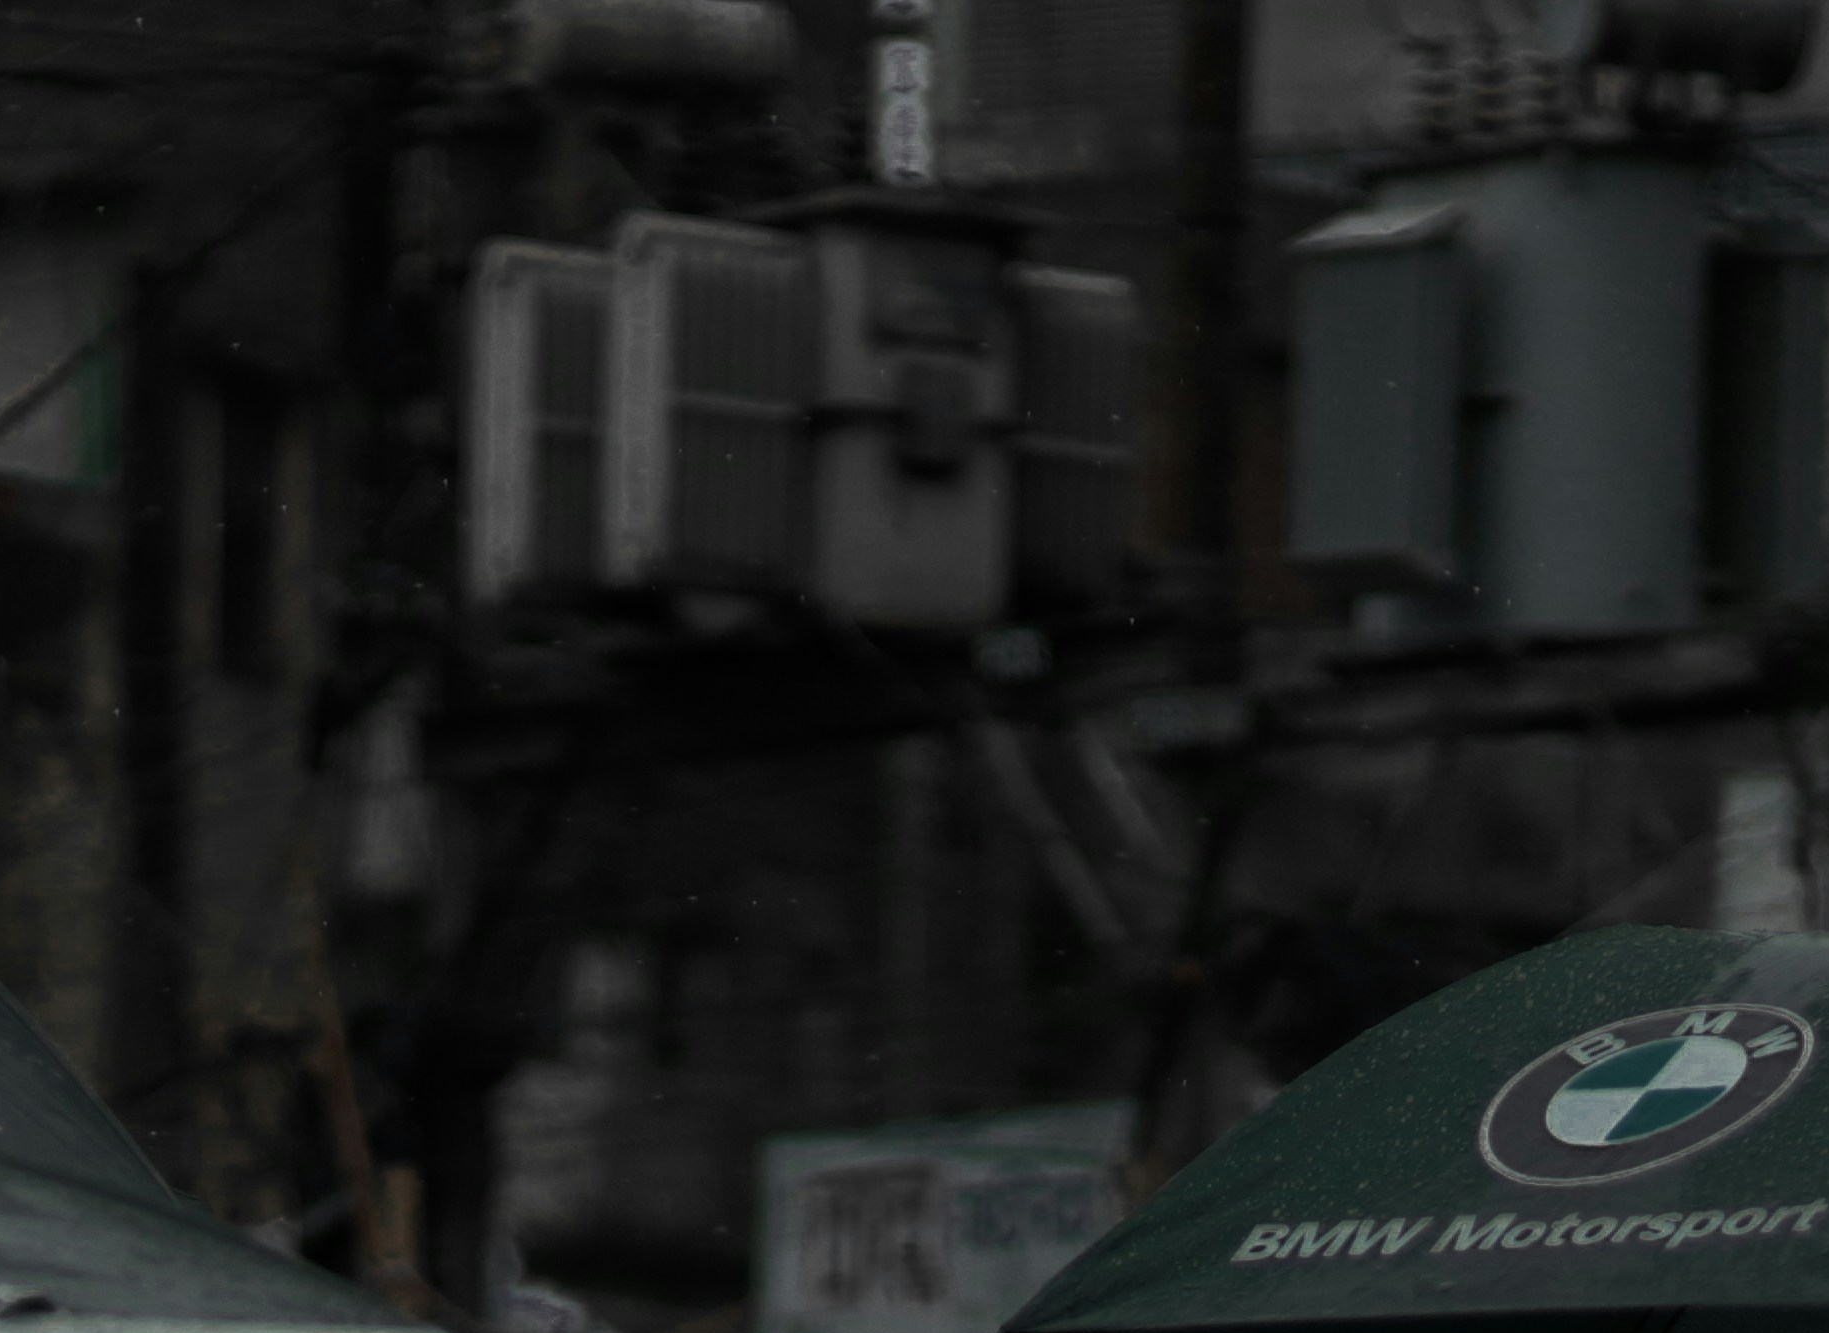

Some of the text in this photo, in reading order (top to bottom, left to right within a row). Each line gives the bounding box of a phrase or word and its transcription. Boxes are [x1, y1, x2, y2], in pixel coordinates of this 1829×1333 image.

[1564, 1009, 1802, 1066] BMW
[1231, 1197, 1829, 1263] BMW Motorsport
